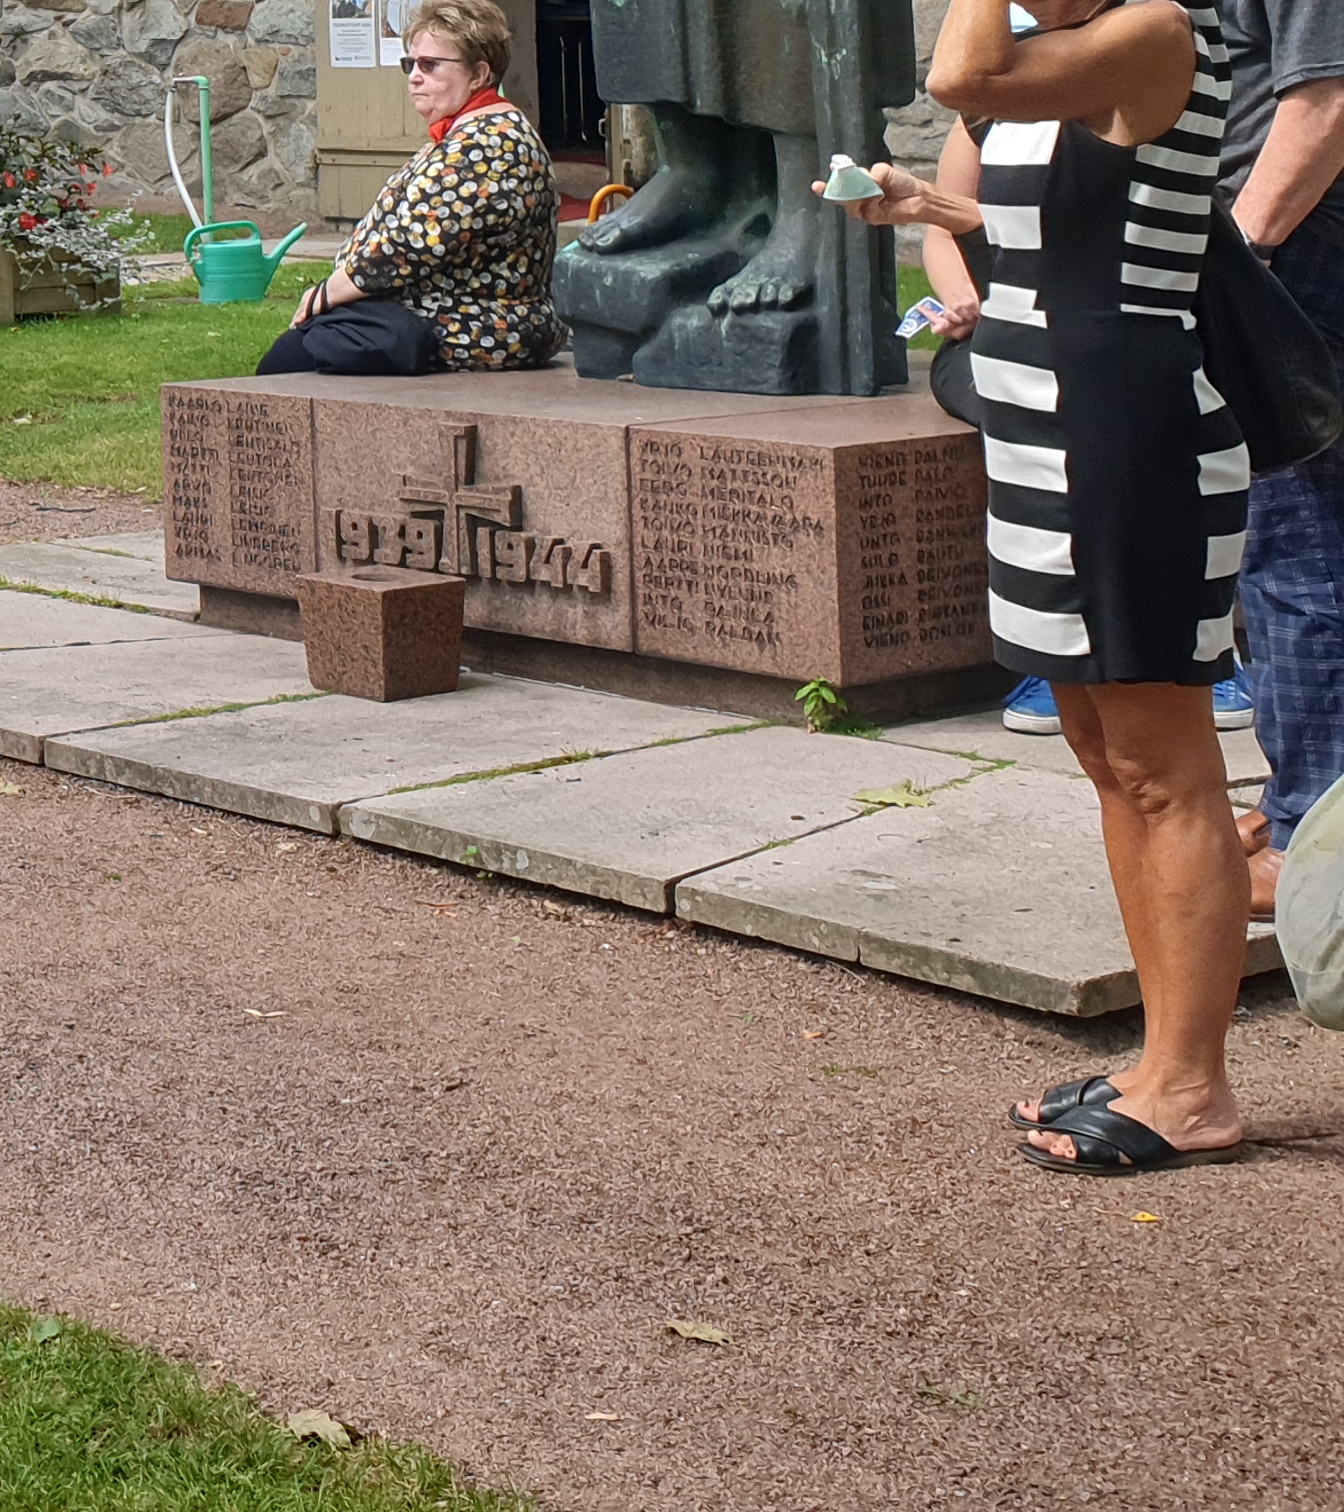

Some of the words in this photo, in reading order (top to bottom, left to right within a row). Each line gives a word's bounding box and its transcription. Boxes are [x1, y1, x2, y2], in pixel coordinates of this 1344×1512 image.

[640, 458, 692, 478] TOIVO
[639, 478, 687, 496] EERO
[641, 515, 695, 535] TOIVO
[318, 508, 443, 572] 1939
[476, 526, 612, 593] 1944
[641, 535, 692, 555] LAURI
